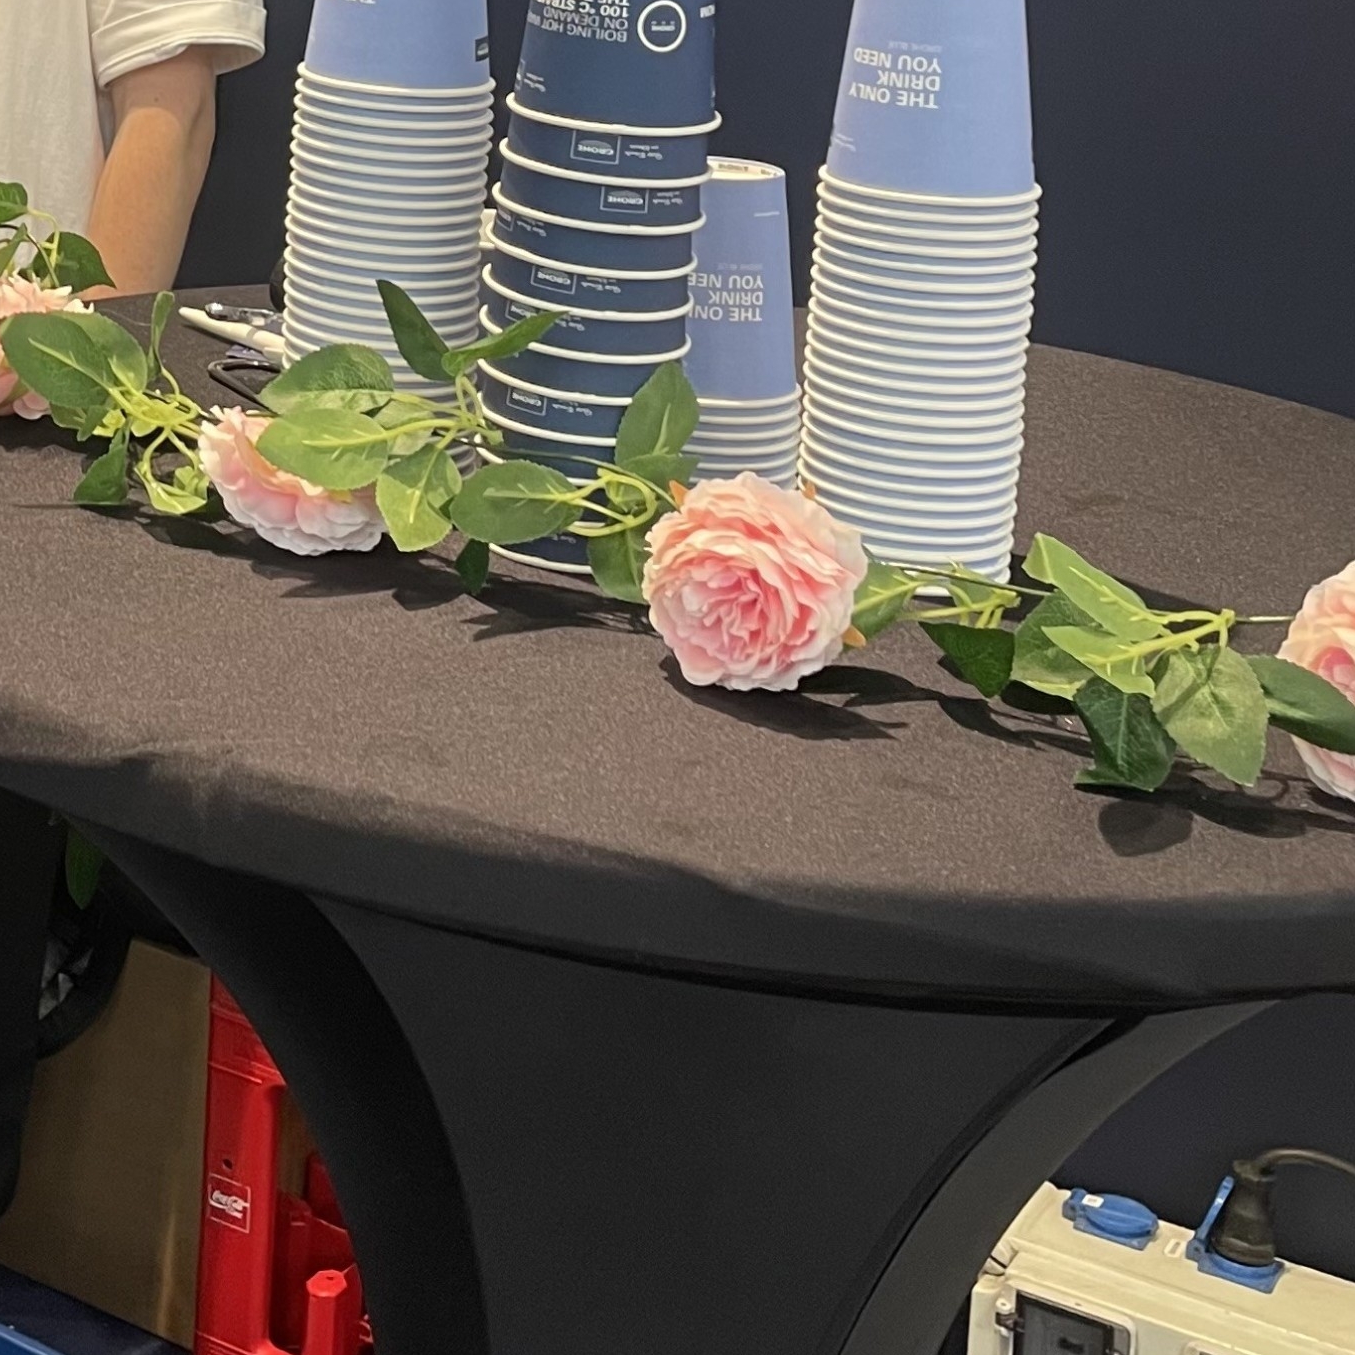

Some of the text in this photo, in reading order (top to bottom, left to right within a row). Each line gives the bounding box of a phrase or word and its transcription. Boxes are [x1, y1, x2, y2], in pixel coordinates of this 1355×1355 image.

[543, 6, 600, 26] DEMAND
[600, 4, 630, 18] 100
[541, 18, 564, 33] HOT
[604, 17, 629, 30] ON
[566, 23, 628, 43] BOILING
[853, 47, 942, 74] YOU NEED
[876, 69, 941, 92] DRINK
[848, 82, 939, 109] THE ONLY
[687, 272, 764, 290] YOU NEE
[708, 290, 764, 306] DRINK
[728, 307, 763, 322] THE
